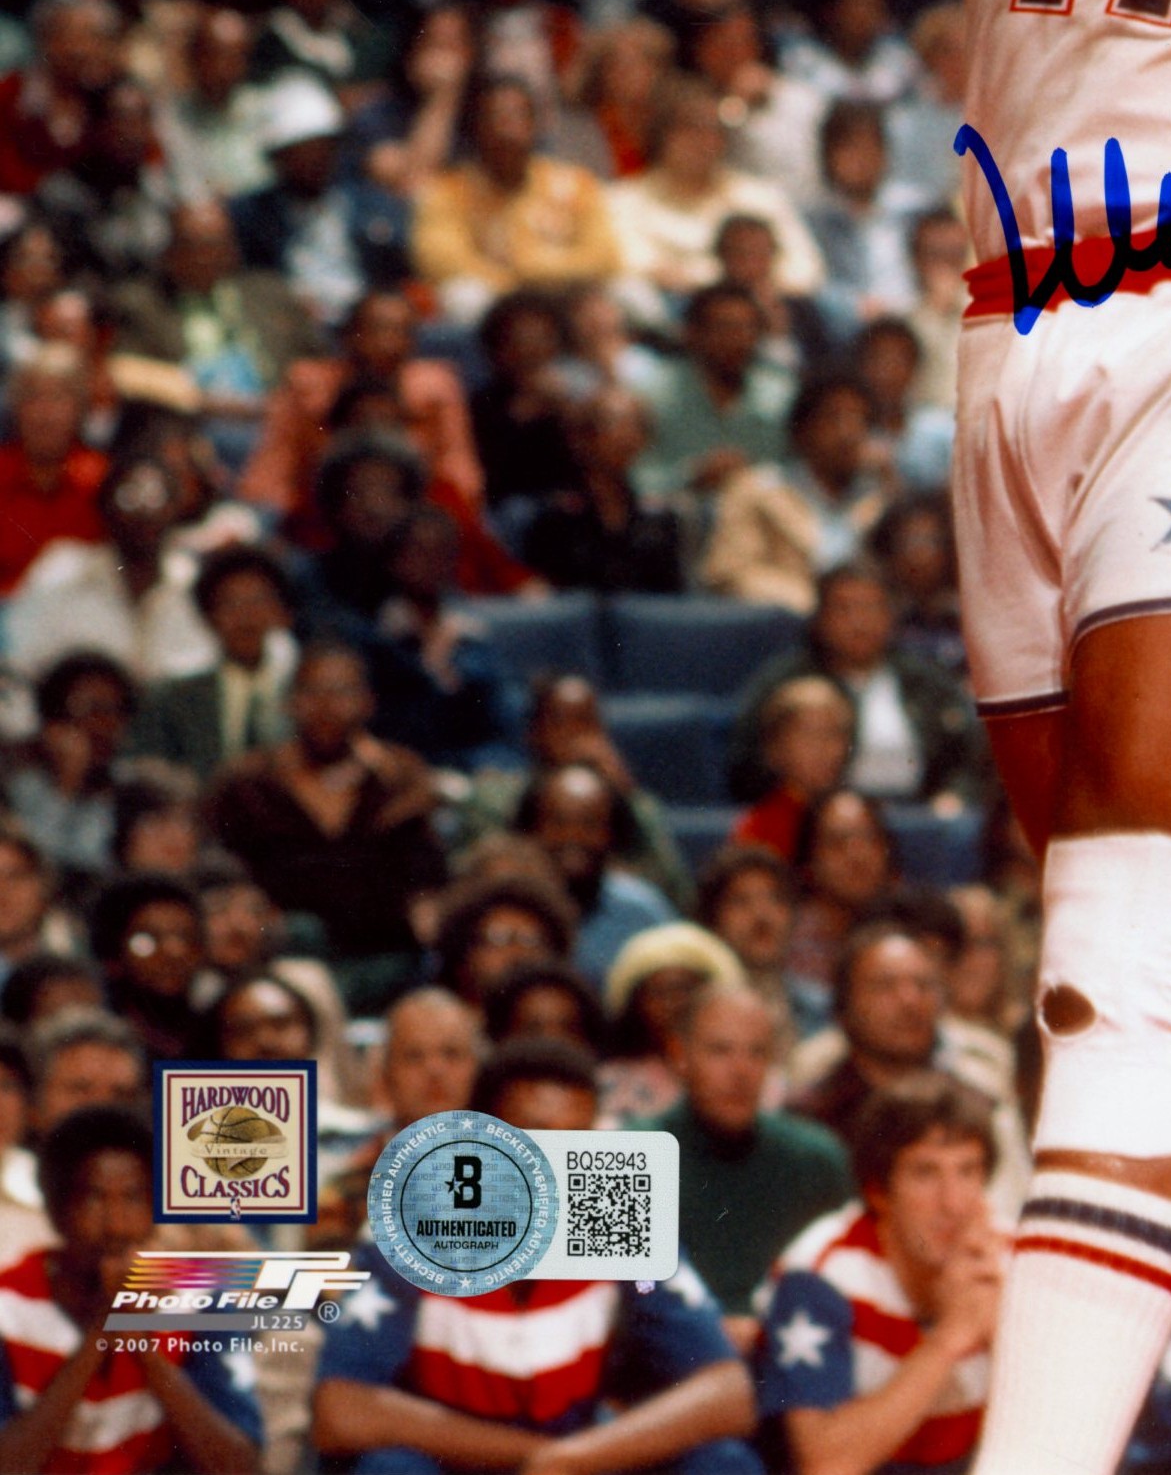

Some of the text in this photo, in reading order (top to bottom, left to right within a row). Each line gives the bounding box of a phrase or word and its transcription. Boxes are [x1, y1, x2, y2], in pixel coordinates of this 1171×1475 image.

[390, 1123, 447, 1177] AUTHENTIC
[485, 1123, 538, 1165] BECKETT
[567, 1151, 647, 1171] BQ52943
[381, 1181, 399, 1242] VERIFIED
[531, 1165, 549, 1227] VERIFIED
[416, 1220, 516, 1237] AUTHENTICATED
[433, 1240, 499, 1250] AUTOGRAPH
[393, 1243, 445, 1284] BECKETT
[485, 1231, 543, 1285] AUTHENTIC
